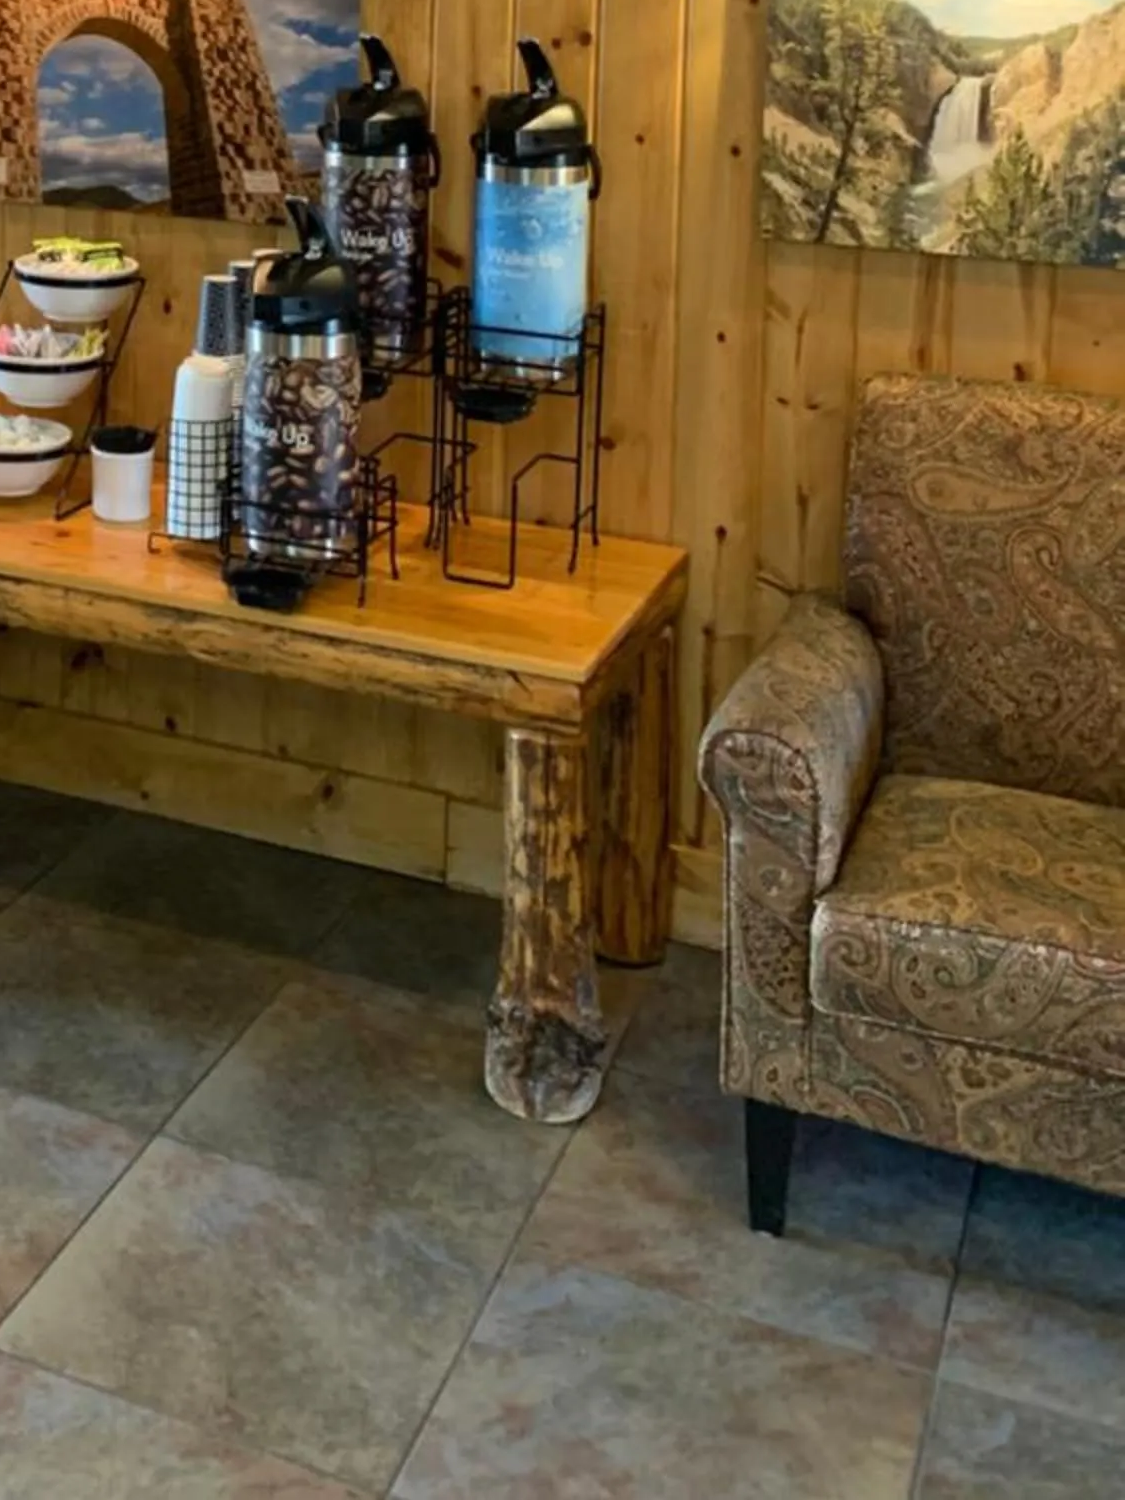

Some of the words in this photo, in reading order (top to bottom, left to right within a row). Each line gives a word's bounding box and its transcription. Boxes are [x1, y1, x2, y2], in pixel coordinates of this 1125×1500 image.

[341, 228, 388, 251] Wake
[392, 227, 415, 255] Up
[282, 423, 310, 450] Up
